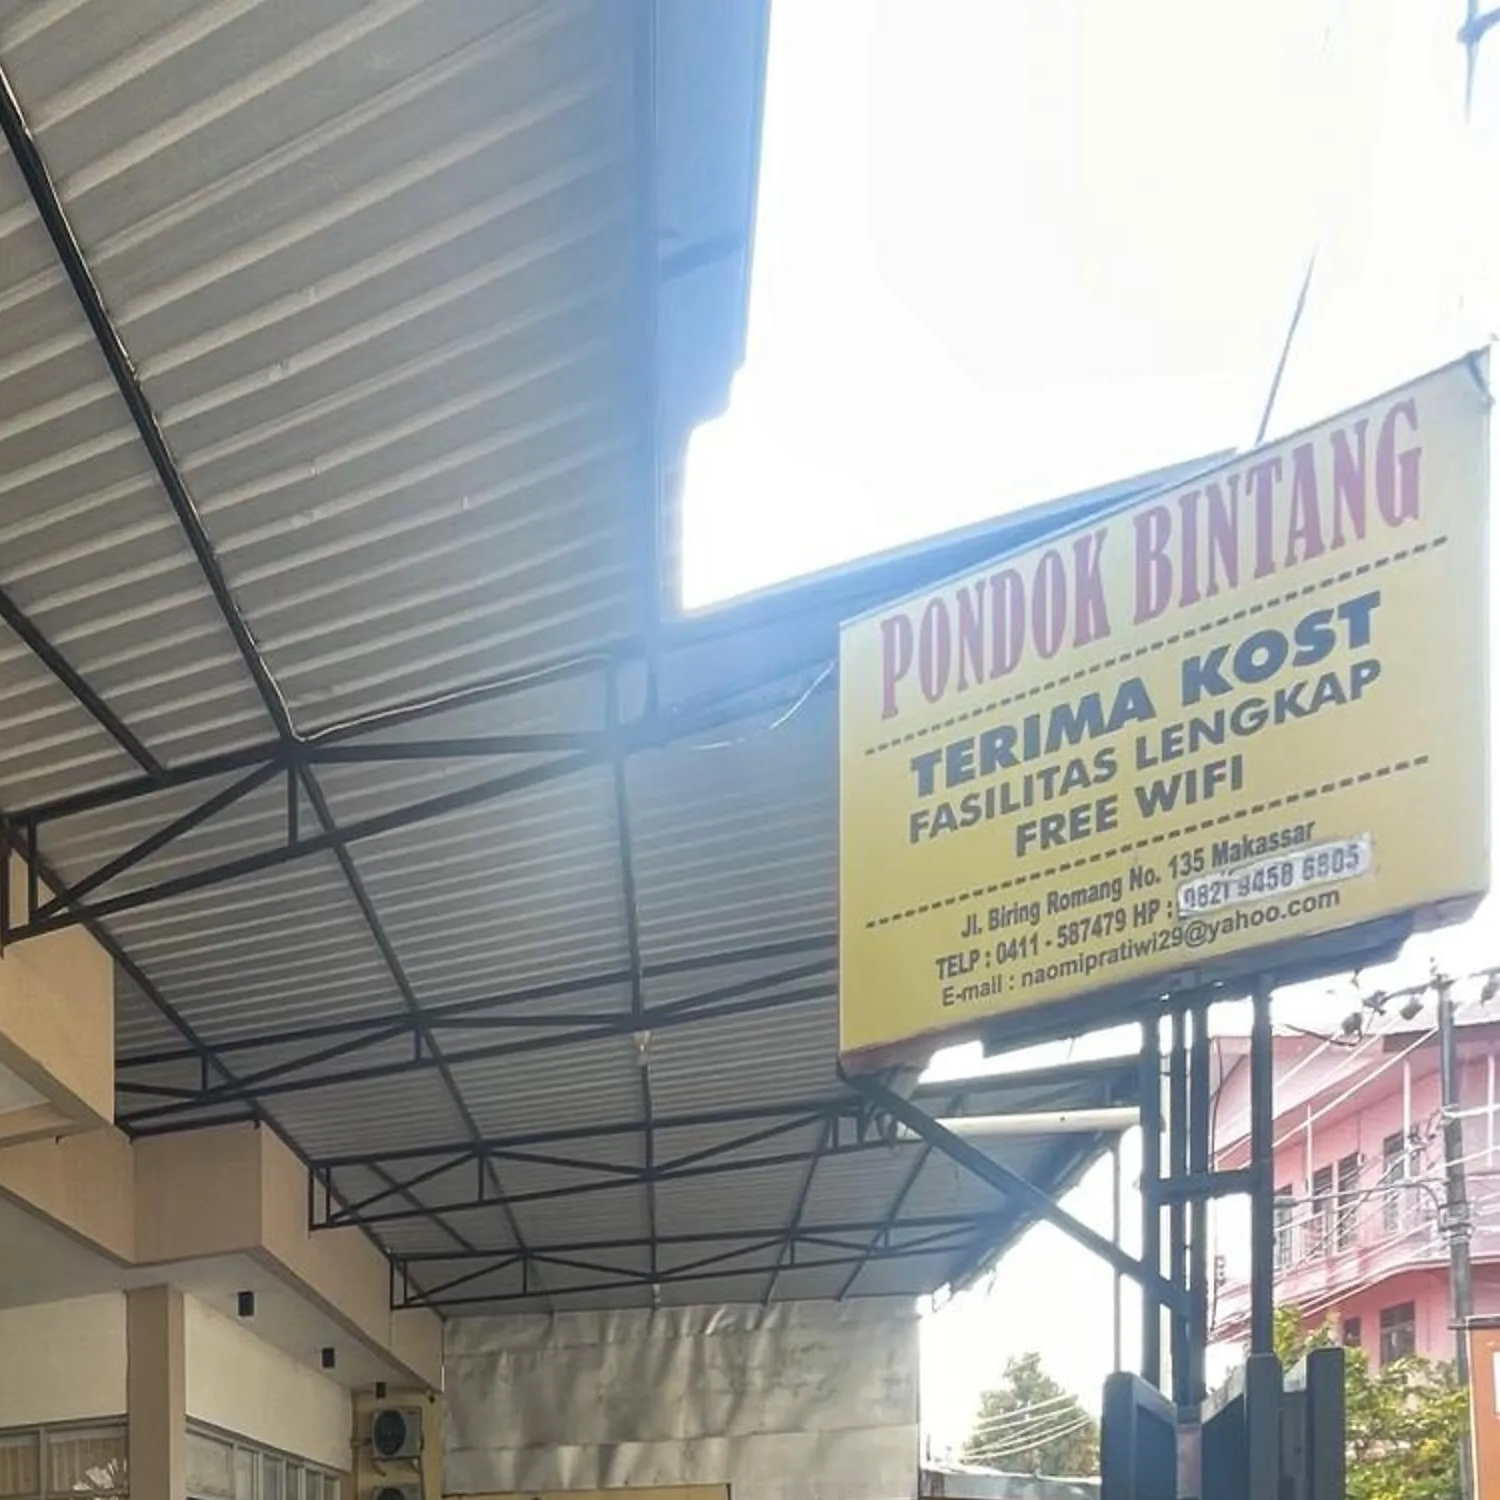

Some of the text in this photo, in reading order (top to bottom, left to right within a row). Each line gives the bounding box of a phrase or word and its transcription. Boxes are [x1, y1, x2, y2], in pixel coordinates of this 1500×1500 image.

[880, 397, 1422, 721] PONDOK BINTANG
[909, 659, 1381, 843] FASILITAS LENGKAP
[910, 590, 1381, 798] TERIMA KOST
[1015, 754, 1243, 857] FREE WIFI
[988, 897, 1041, 928] Biring
[1047, 878, 1123, 915] Romang
[1129, 866, 1161, 896] No.
[1168, 848, 1205, 879] 135
[1211, 819, 1316, 866] Makassar
[936, 949, 980, 981] TELP
[996, 936, 1040, 966] 0411
[1056, 913, 1126, 950] 587479
[1133, 899, 1161, 927] HP
[942, 975, 1002, 1006] E-mail
[1021, 889, 1339, 988] naomipratiwi29@yahoo.com
